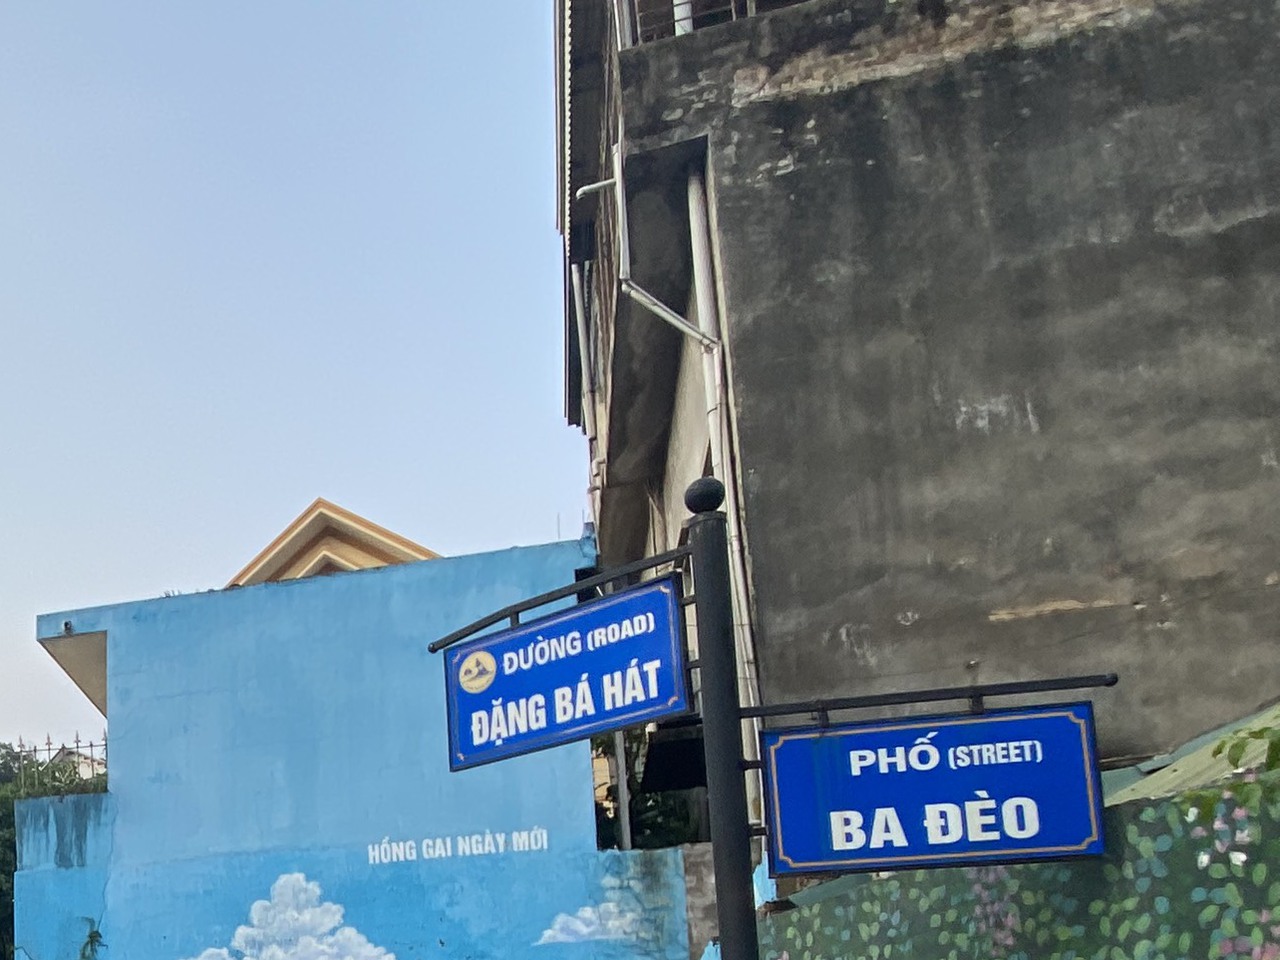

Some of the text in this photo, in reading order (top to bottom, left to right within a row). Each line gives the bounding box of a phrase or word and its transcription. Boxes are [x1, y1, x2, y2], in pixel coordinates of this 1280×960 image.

[503, 612, 655, 675] ĐƯỜNG (ROAD)
[471, 658, 661, 747] ĐẶNG BÁ HÁT
[849, 731, 1044, 776] PHỐ (STREET)
[422, 836, 452, 859] GAI
[457, 829, 506, 857] NGÀY
[511, 825, 548, 852] MỚI
[829, 790, 1040, 851] BA ĐÈO
